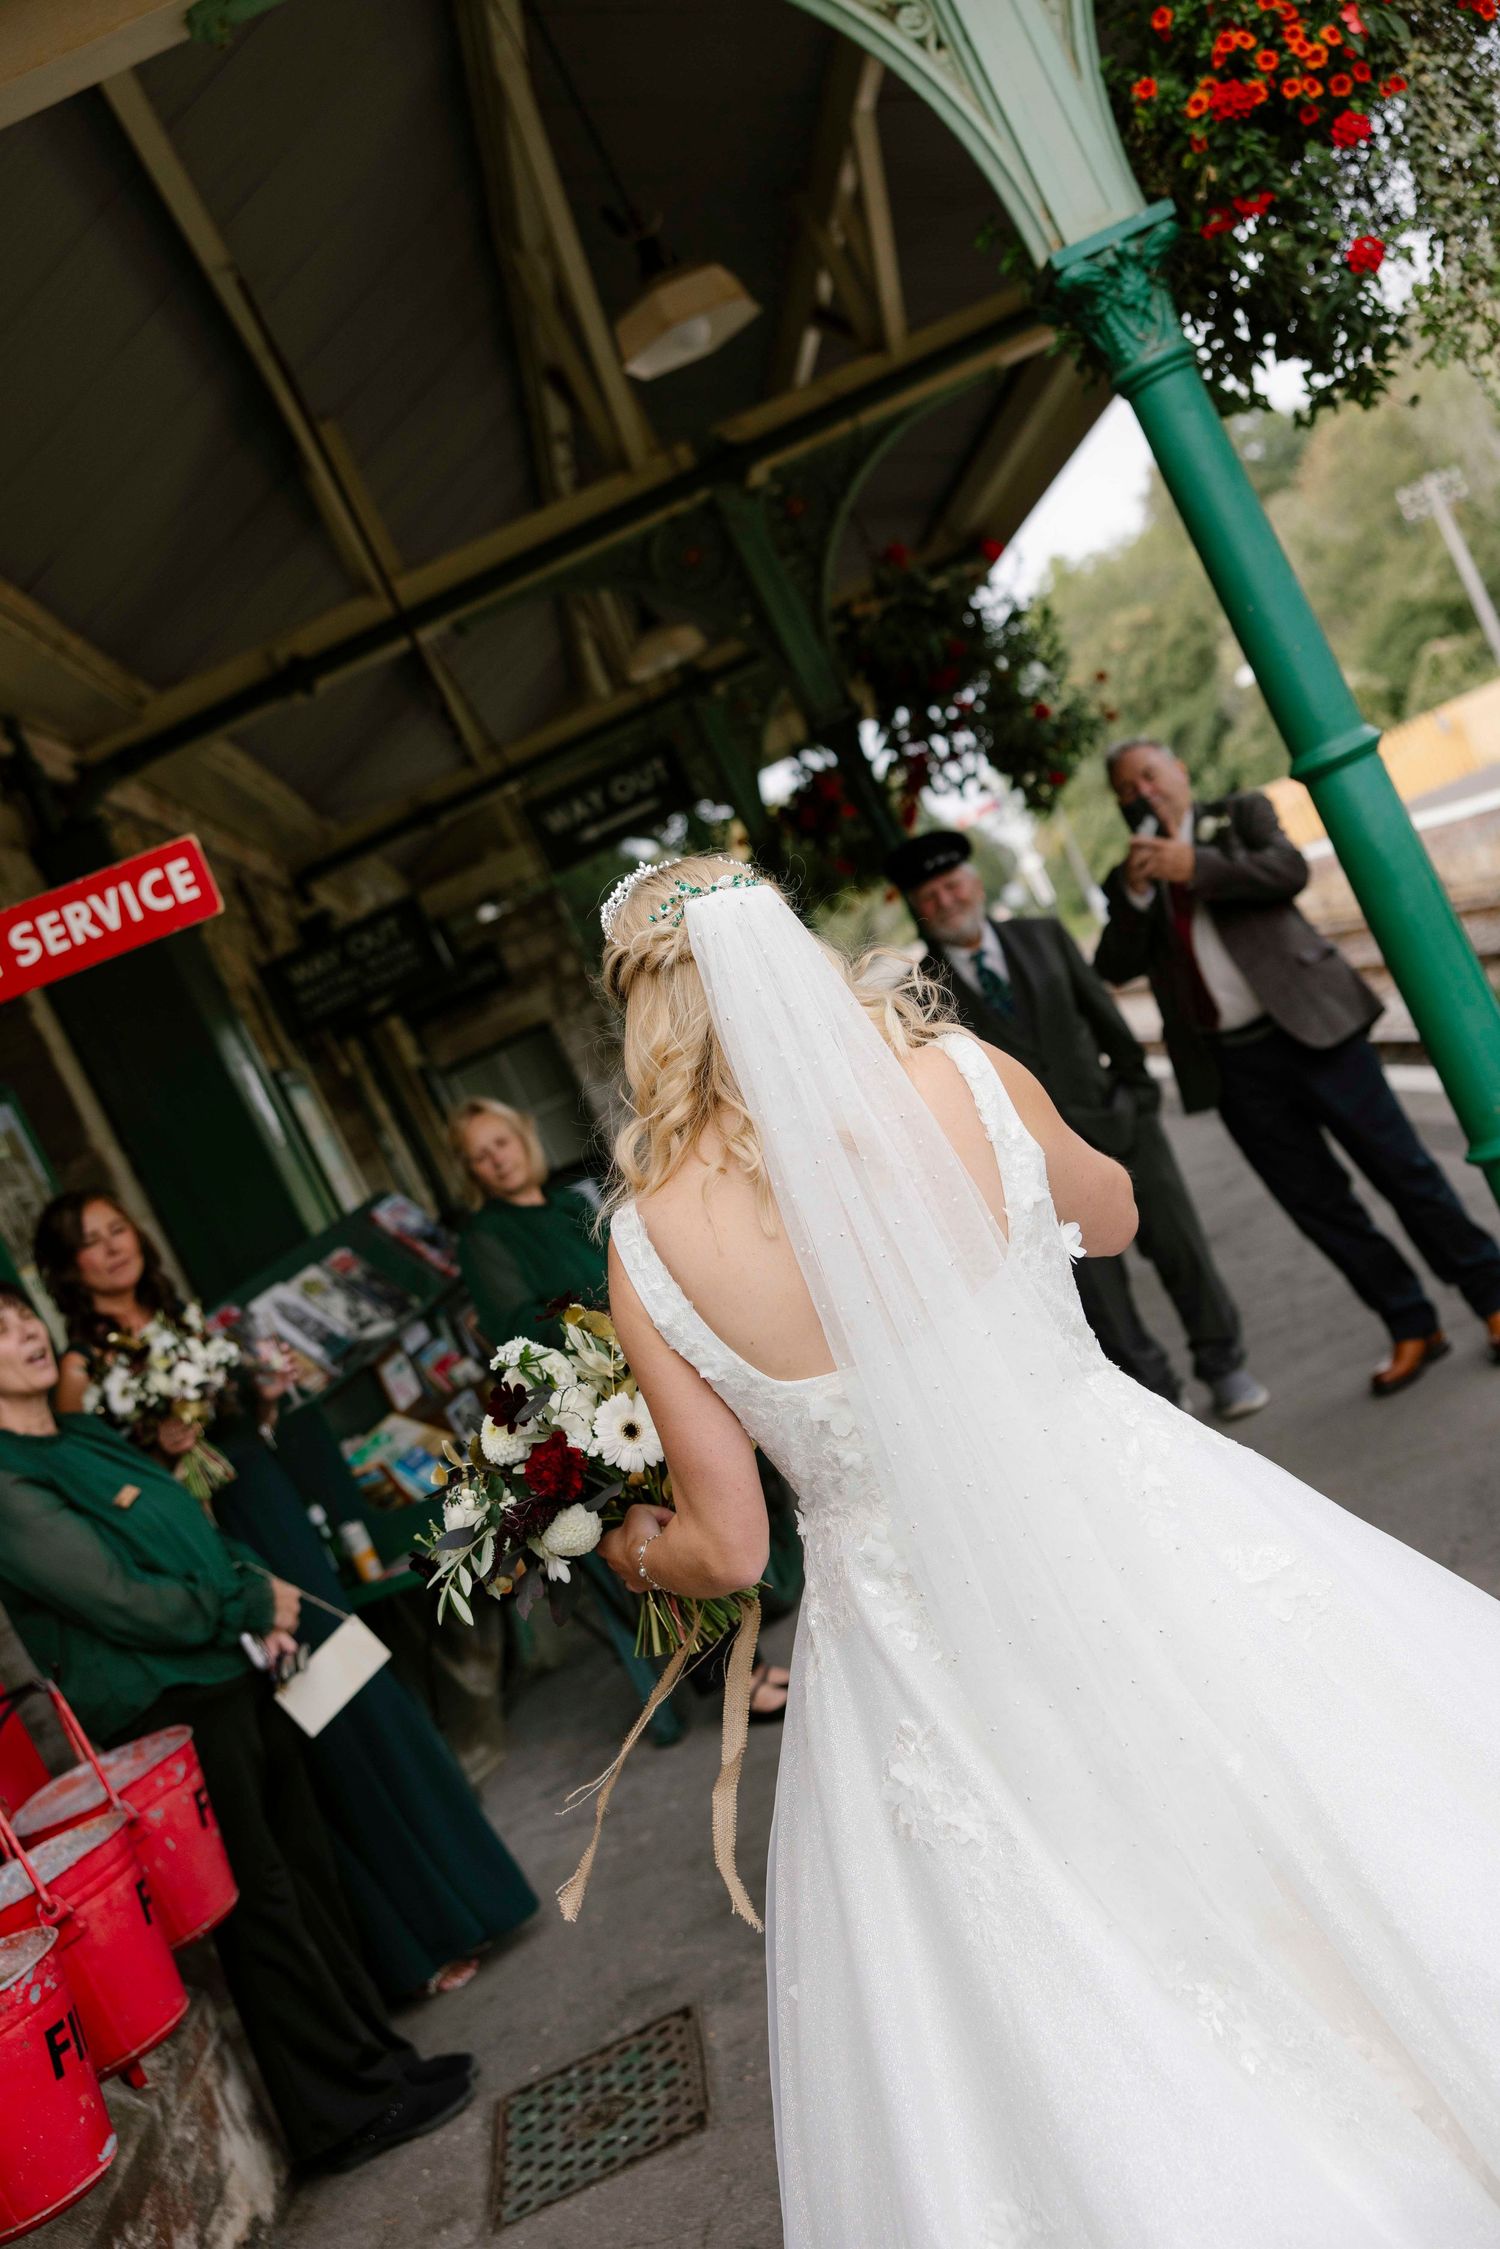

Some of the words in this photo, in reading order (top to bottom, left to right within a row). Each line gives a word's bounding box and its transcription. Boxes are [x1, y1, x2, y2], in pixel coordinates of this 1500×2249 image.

[541, 785, 605, 833] WAY
[608, 755, 670, 803] OUT
[7, 856, 202, 968] SERVICE
[345, 916, 401, 959] OUT
[44, 2003, 89, 2081] FI
